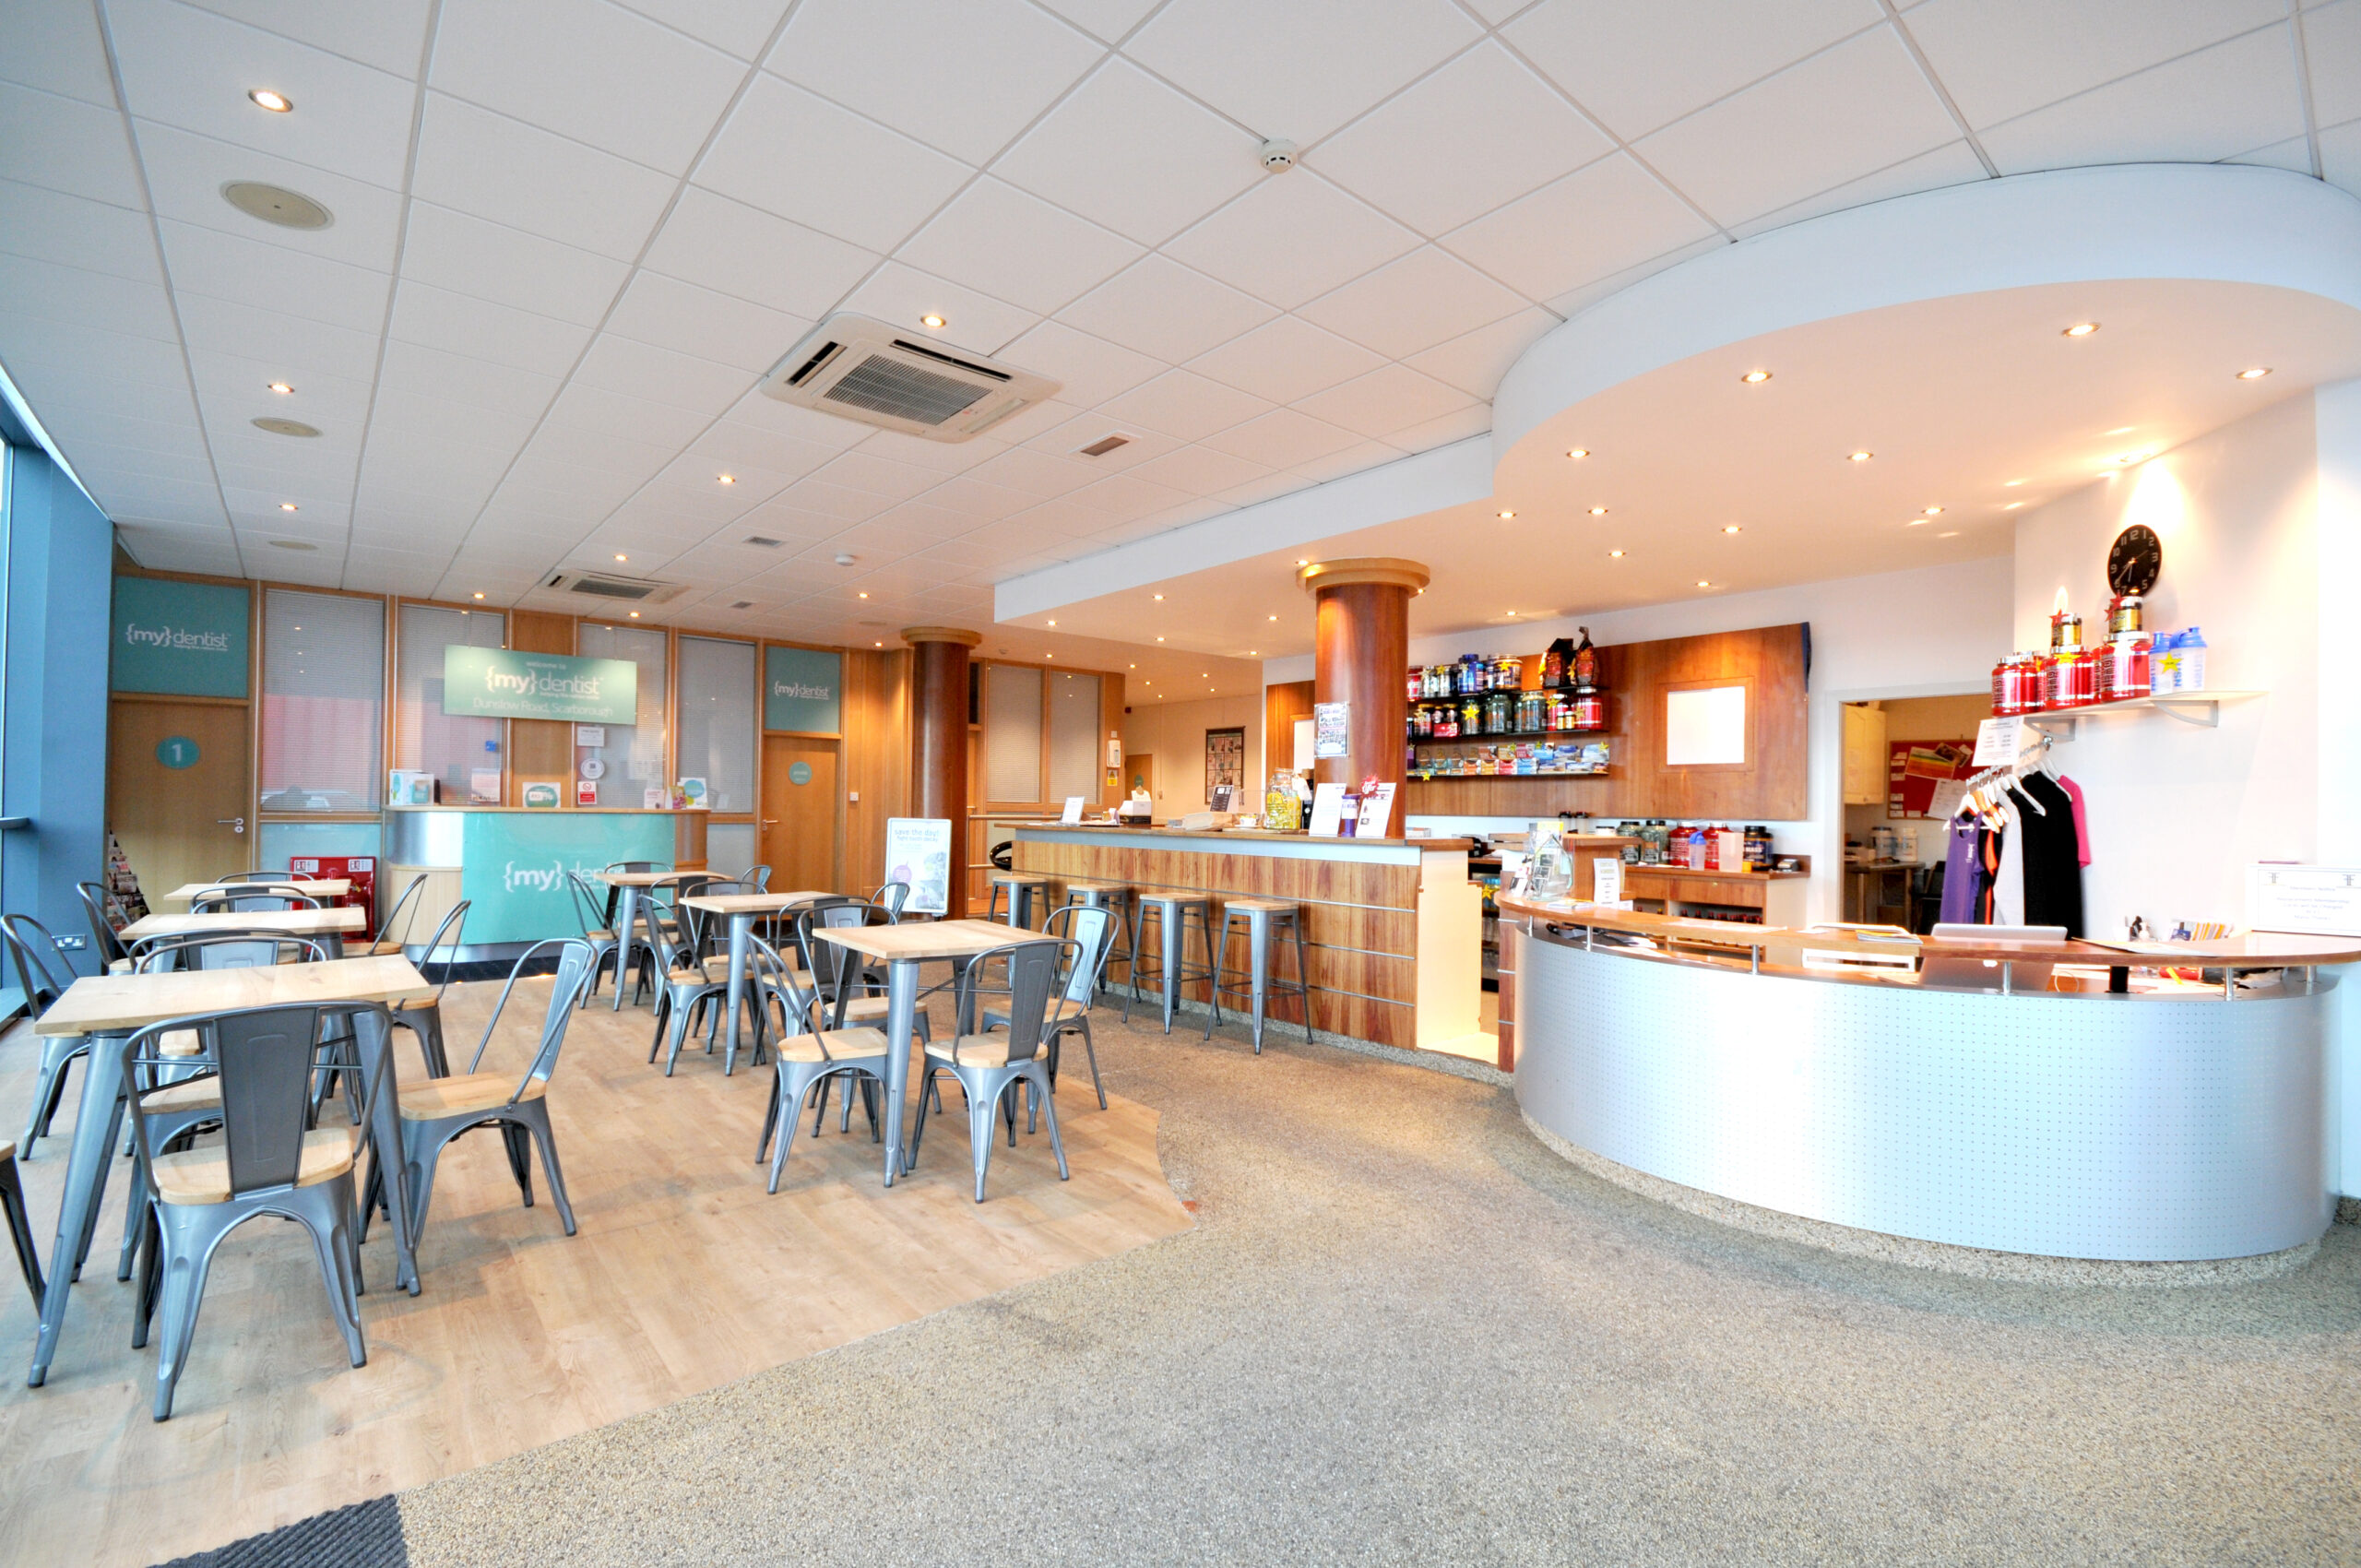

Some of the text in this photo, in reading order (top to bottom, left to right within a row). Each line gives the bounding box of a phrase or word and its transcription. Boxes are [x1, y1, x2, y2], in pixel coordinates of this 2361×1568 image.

[2130, 529, 2139, 540] 12
[2142, 529, 2147, 540] 1
[2120, 536, 2127, 546] 11
[2148, 536, 2154, 547] 2
[2112, 547, 2120, 558] 10
[2151, 552, 2159, 563] 3
[2110, 564, 2118, 575] 9
[2148, 568, 2155, 578] 4
[2142, 578, 2148, 590] 5
[2120, 585, 2128, 596] 7
[552, 702, 613, 718] Scarborough
[172, 743, 183, 763] 1
